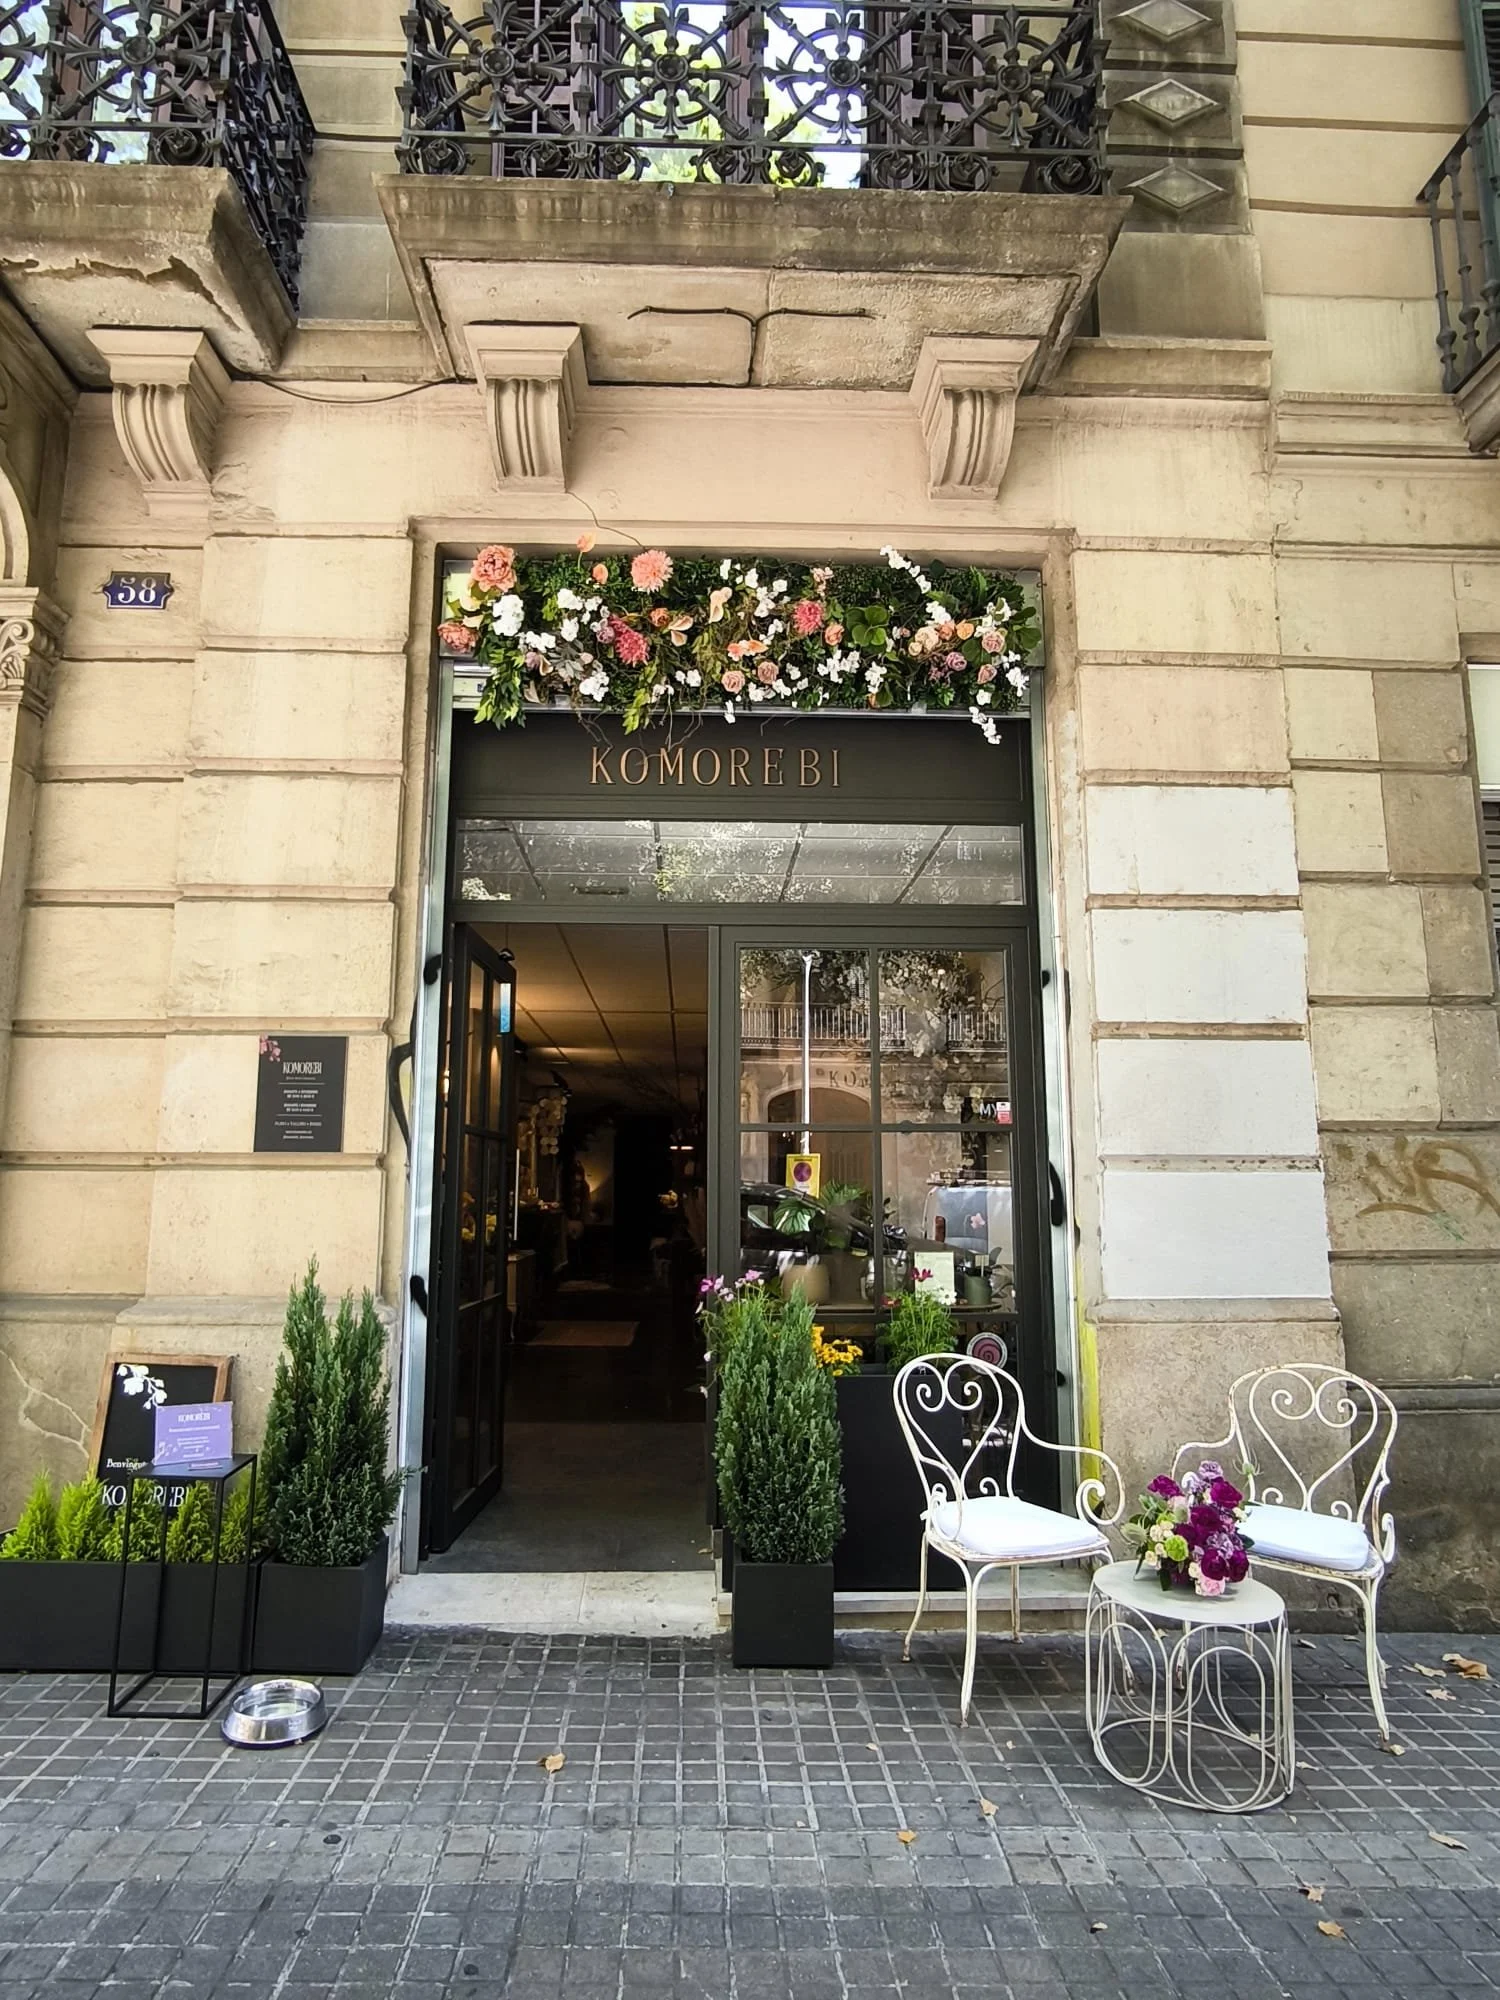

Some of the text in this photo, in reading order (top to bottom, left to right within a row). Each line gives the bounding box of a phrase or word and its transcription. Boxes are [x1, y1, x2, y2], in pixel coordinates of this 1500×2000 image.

[117, 576, 156, 604] 58
[589, 747, 841, 787] KOMOREBI
[282, 1062, 322, 1074] KOMOREBI
